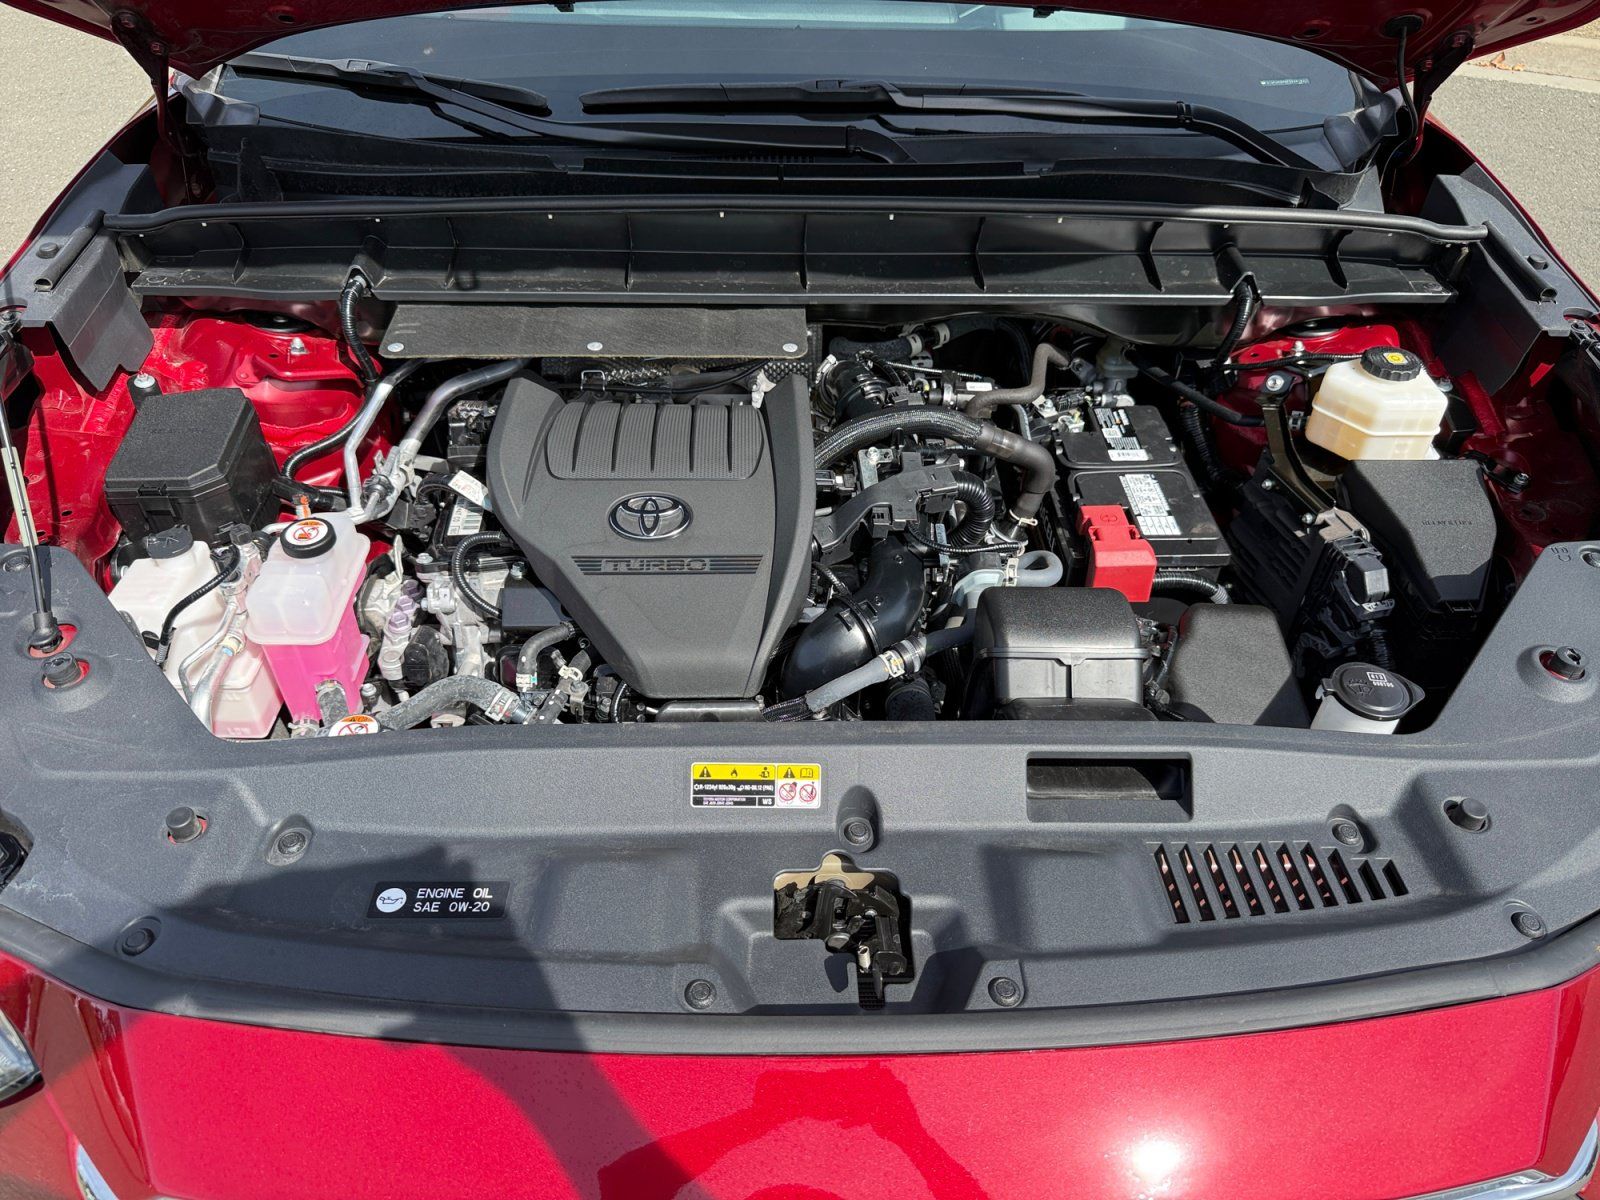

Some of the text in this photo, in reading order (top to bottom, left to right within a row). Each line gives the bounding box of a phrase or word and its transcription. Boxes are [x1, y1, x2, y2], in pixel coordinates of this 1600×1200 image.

[605, 558, 707, 571] TURBO
[416, 888, 493, 899] ENGINE OIL
[413, 901, 490, 913] SAE 0W-20
